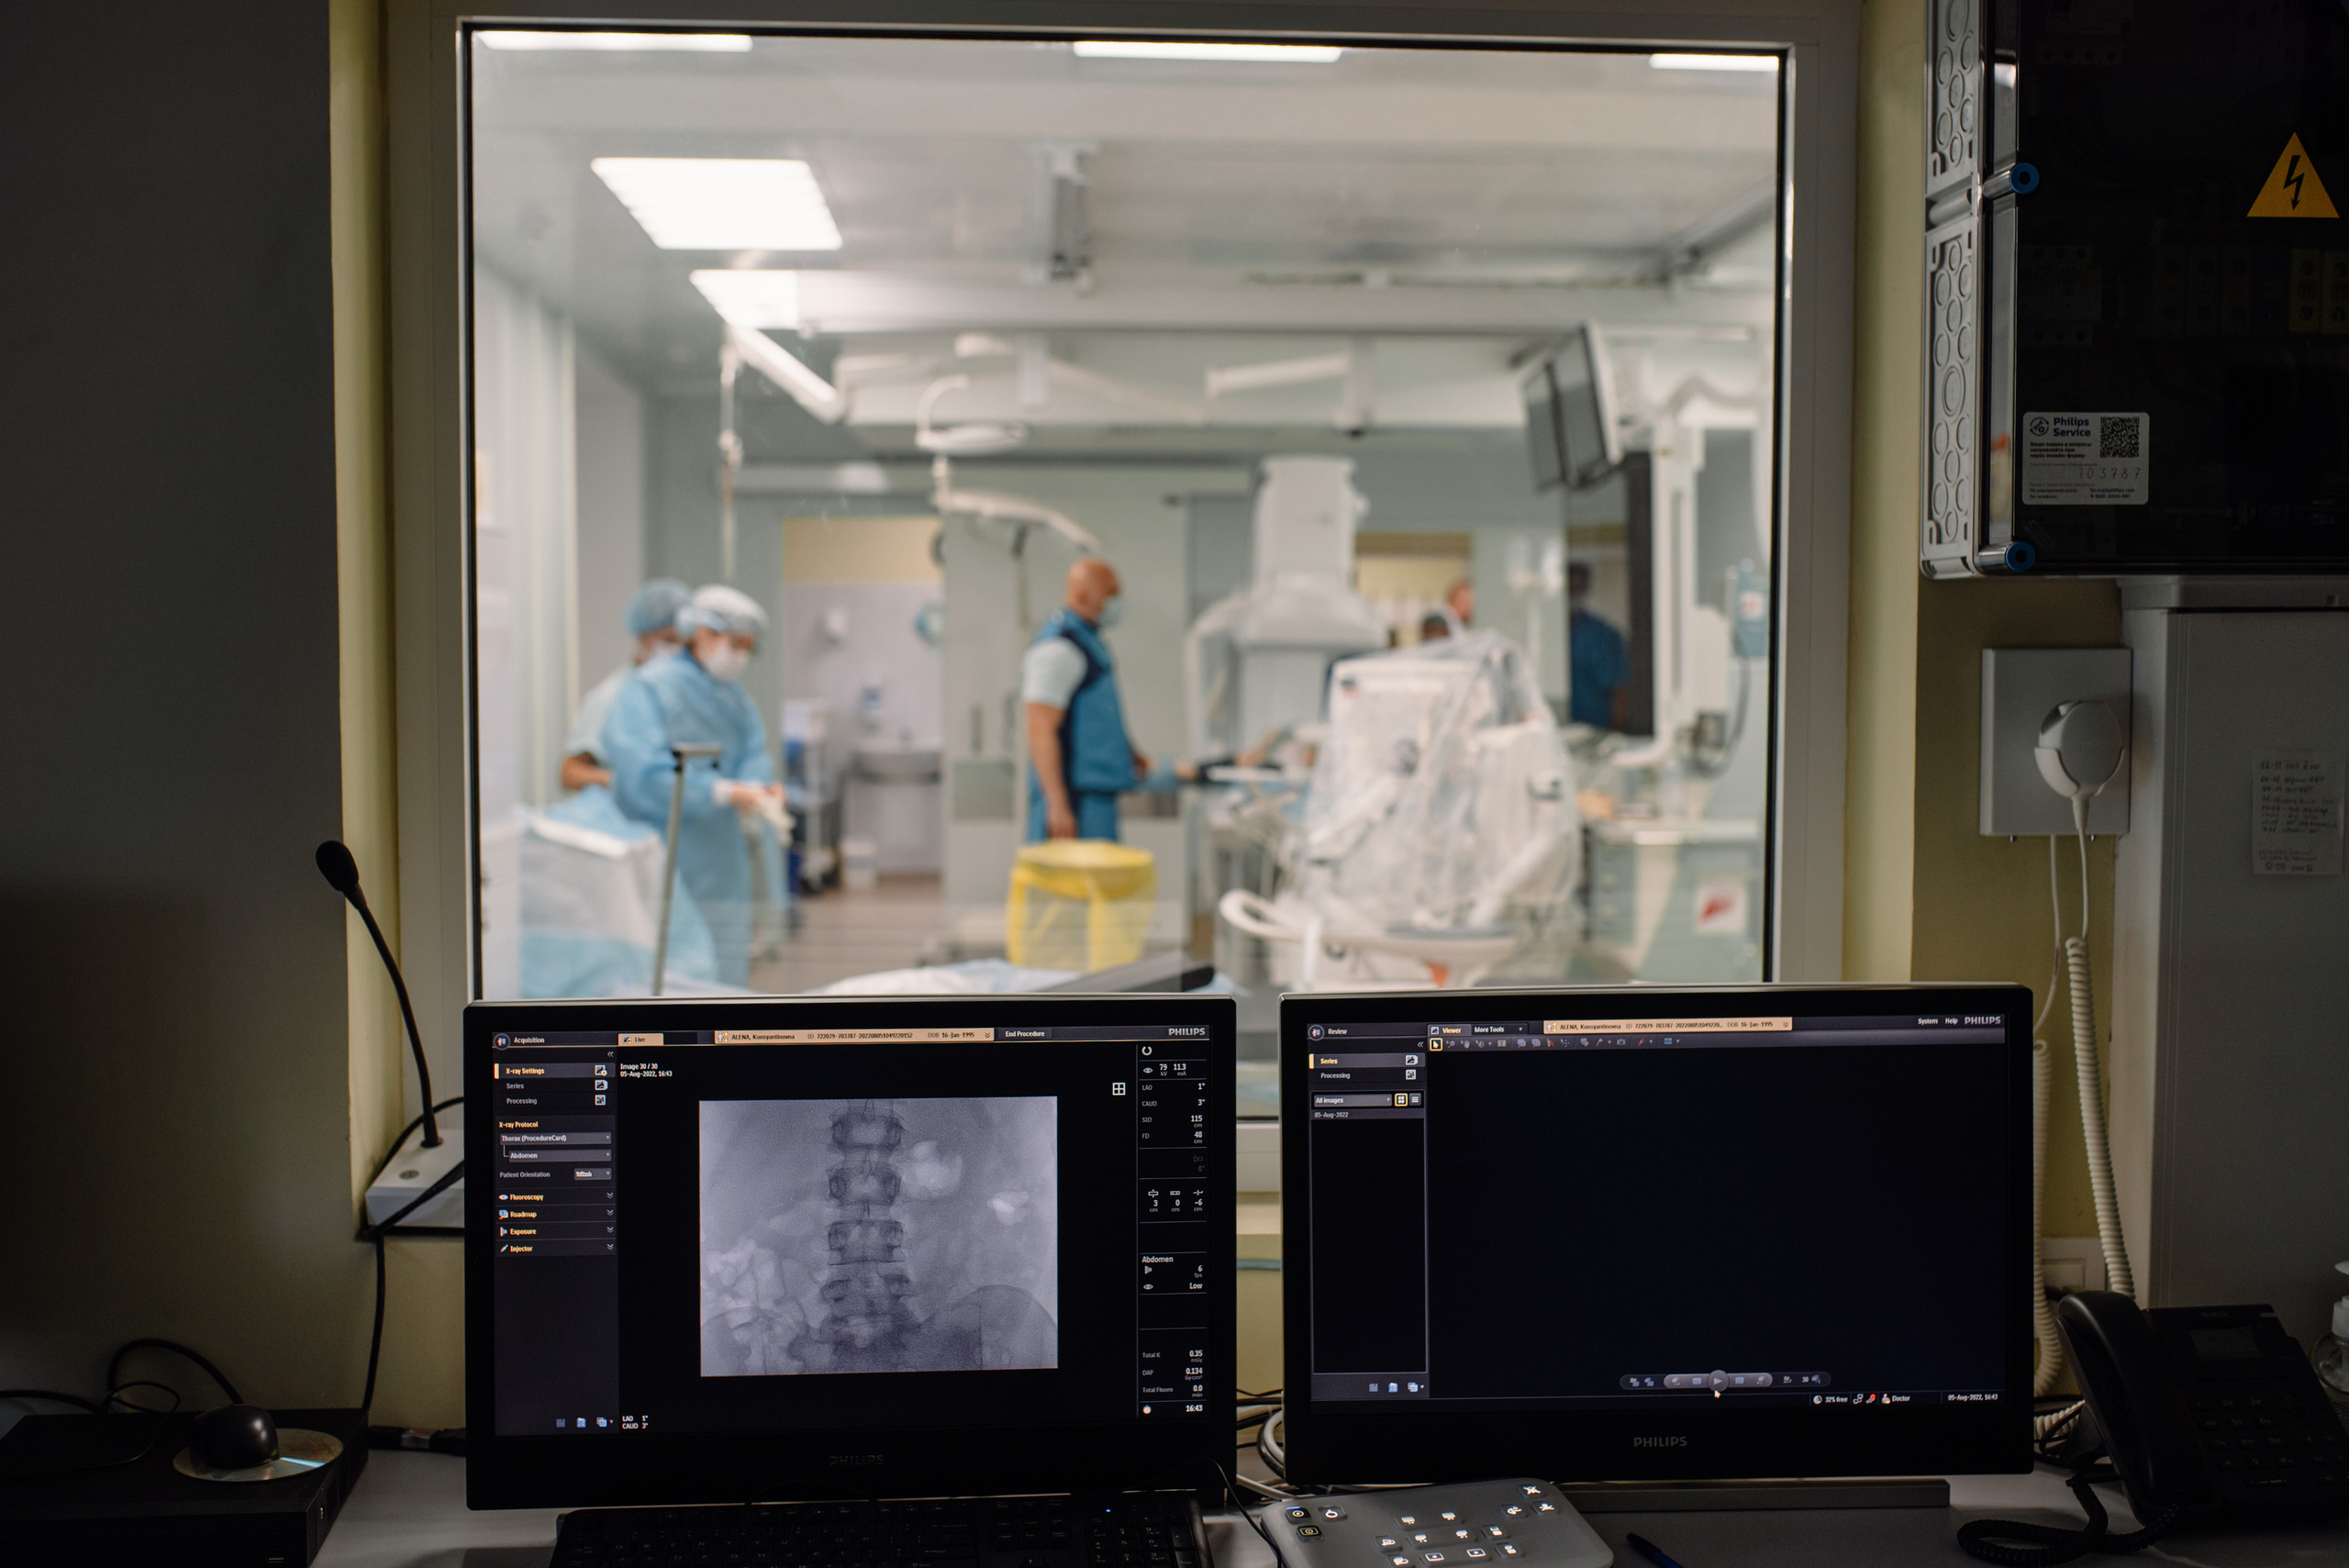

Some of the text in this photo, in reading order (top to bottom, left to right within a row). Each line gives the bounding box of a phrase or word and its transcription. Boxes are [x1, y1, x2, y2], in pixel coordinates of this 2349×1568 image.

[2054, 417, 2089, 428] Philips
[2054, 428, 2091, 437] Service
[1944, 1017, 1958, 1025] Help
[1964, 1016, 2001, 1025] PHILIPS
[1168, 1028, 1206, 1036] PHILIPS
[514, 1037, 545, 1045] Acquisition
[521, 1067, 545, 1075] Settings
[521, 1134, 567, 1142] (ProcedureCard)
[1633, 1436, 1687, 1448] PHILIPS
[829, 1454, 885, 1467] PHILIPS
